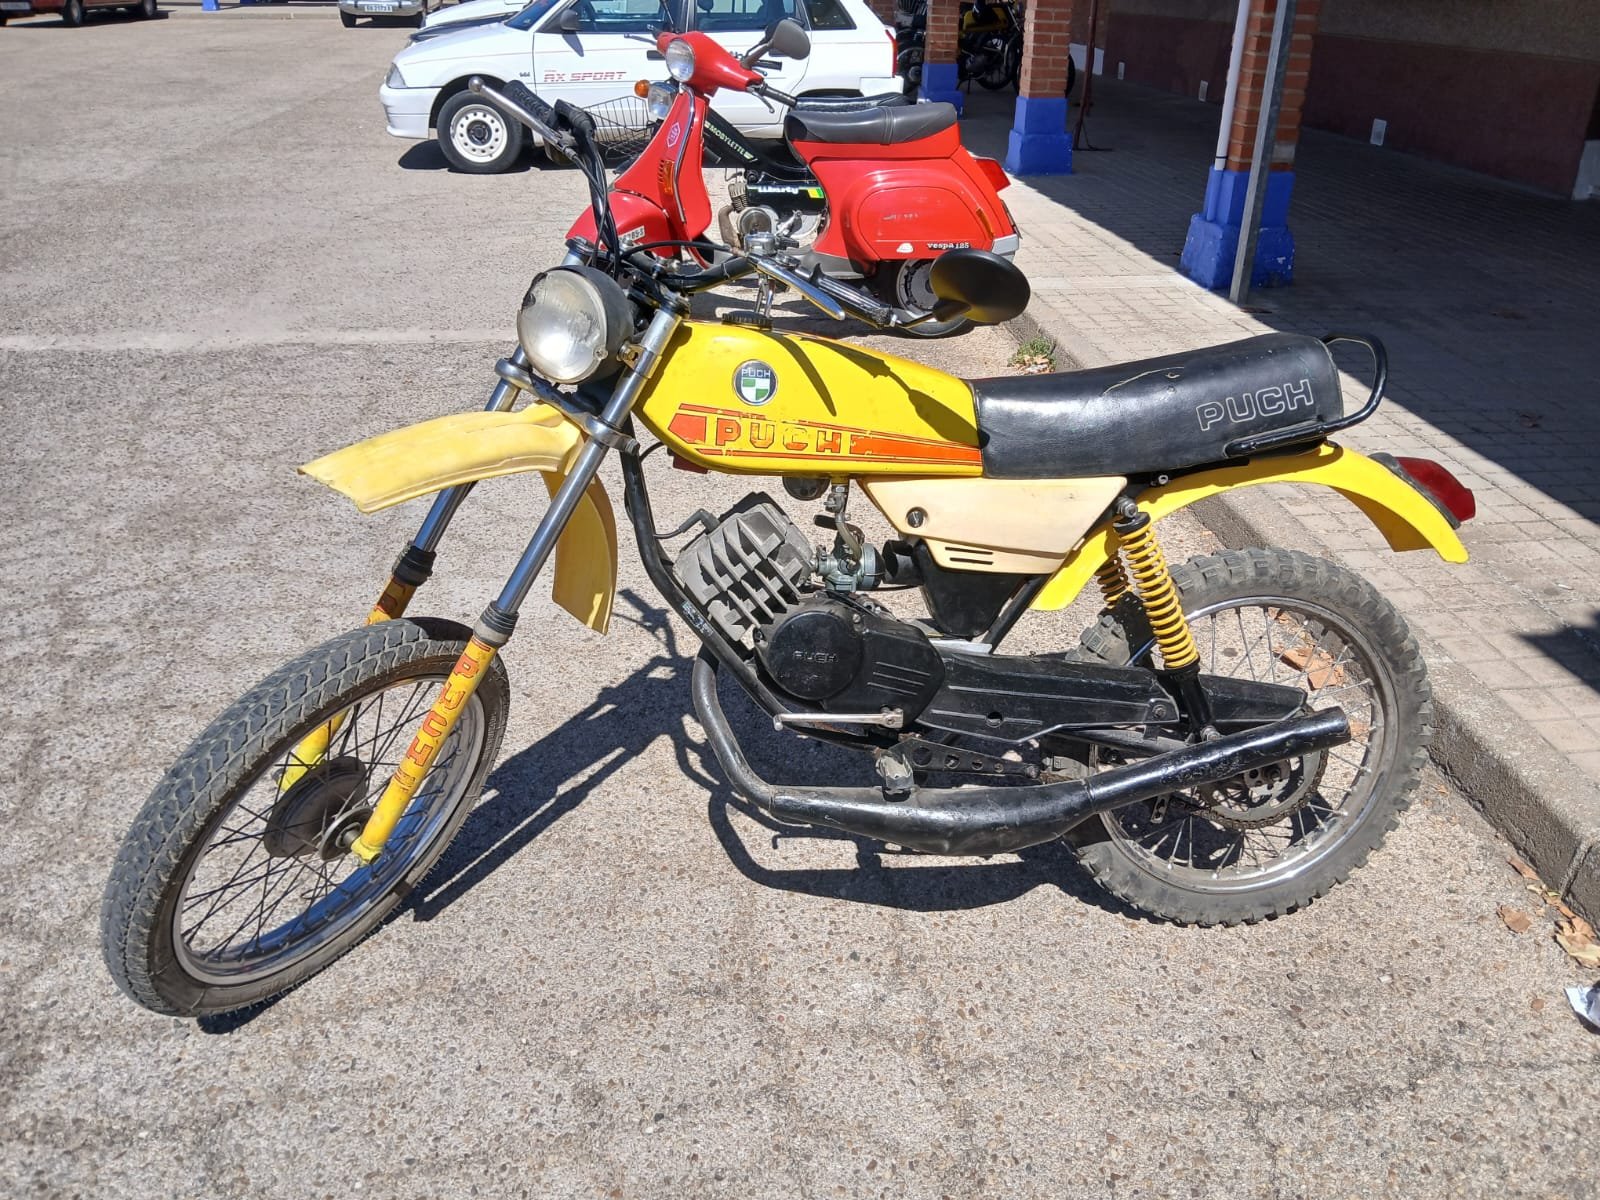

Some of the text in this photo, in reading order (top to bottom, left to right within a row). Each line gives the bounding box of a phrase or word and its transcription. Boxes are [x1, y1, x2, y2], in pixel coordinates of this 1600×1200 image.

[570, 71, 627, 81] SPORT
[709, 124, 746, 155] MOBYLETTE
[741, 368, 771, 378] PUCH
[1195, 379, 1314, 431] PUCH
[715, 417, 842, 453] PUCH
[792, 649, 839, 664] PUCH
[406, 653, 480, 768] PUCH
